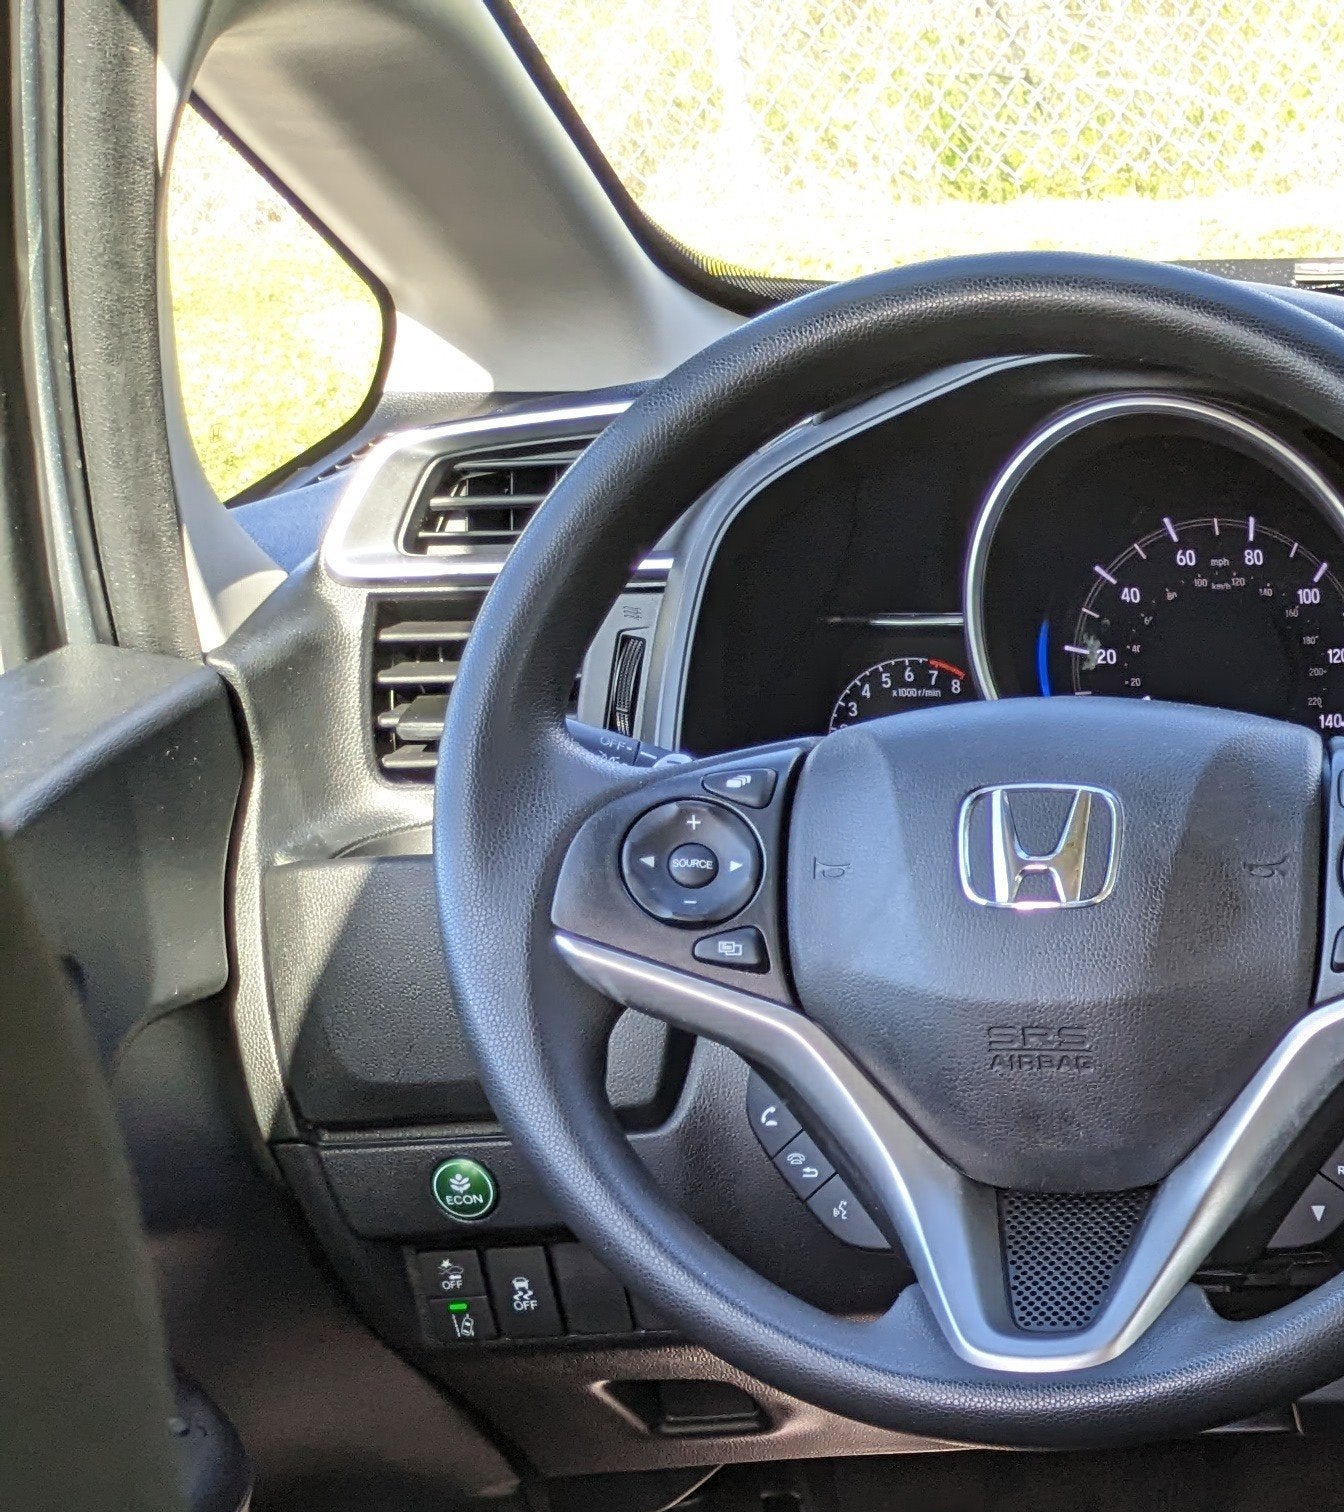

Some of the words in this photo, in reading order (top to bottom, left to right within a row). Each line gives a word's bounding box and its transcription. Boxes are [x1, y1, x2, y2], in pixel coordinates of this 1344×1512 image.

[1176, 549, 1196, 566] 60
[1210, 558, 1229, 567] mph
[1244, 549, 1264, 566] 80
[1194, 578, 1208, 587] 100
[1231, 577, 1245, 586] 120
[1121, 587, 1140, 603] 40
[1297, 588, 1321, 604] 100
[1096, 649, 1117, 664] 20
[881, 673, 891, 688] 5
[904, 667, 914, 682] 6
[928, 670, 938, 685] 7
[1130, 678, 1141, 686] 20
[861, 683, 871, 698] 4
[918, 688, 941, 697] r/min
[951, 679, 961, 693] 8
[848, 701, 858, 716] 3
[1307, 697, 1322, 706] 220
[1319, 713, 1342, 729] 140
[672, 858, 713, 870] SOURCE
[987, 1025, 1087, 1046] SRS
[445, 1194, 484, 1206] ECON
[441, 1280, 463, 1290] OFF
[513, 1300, 538, 1311] OFF
